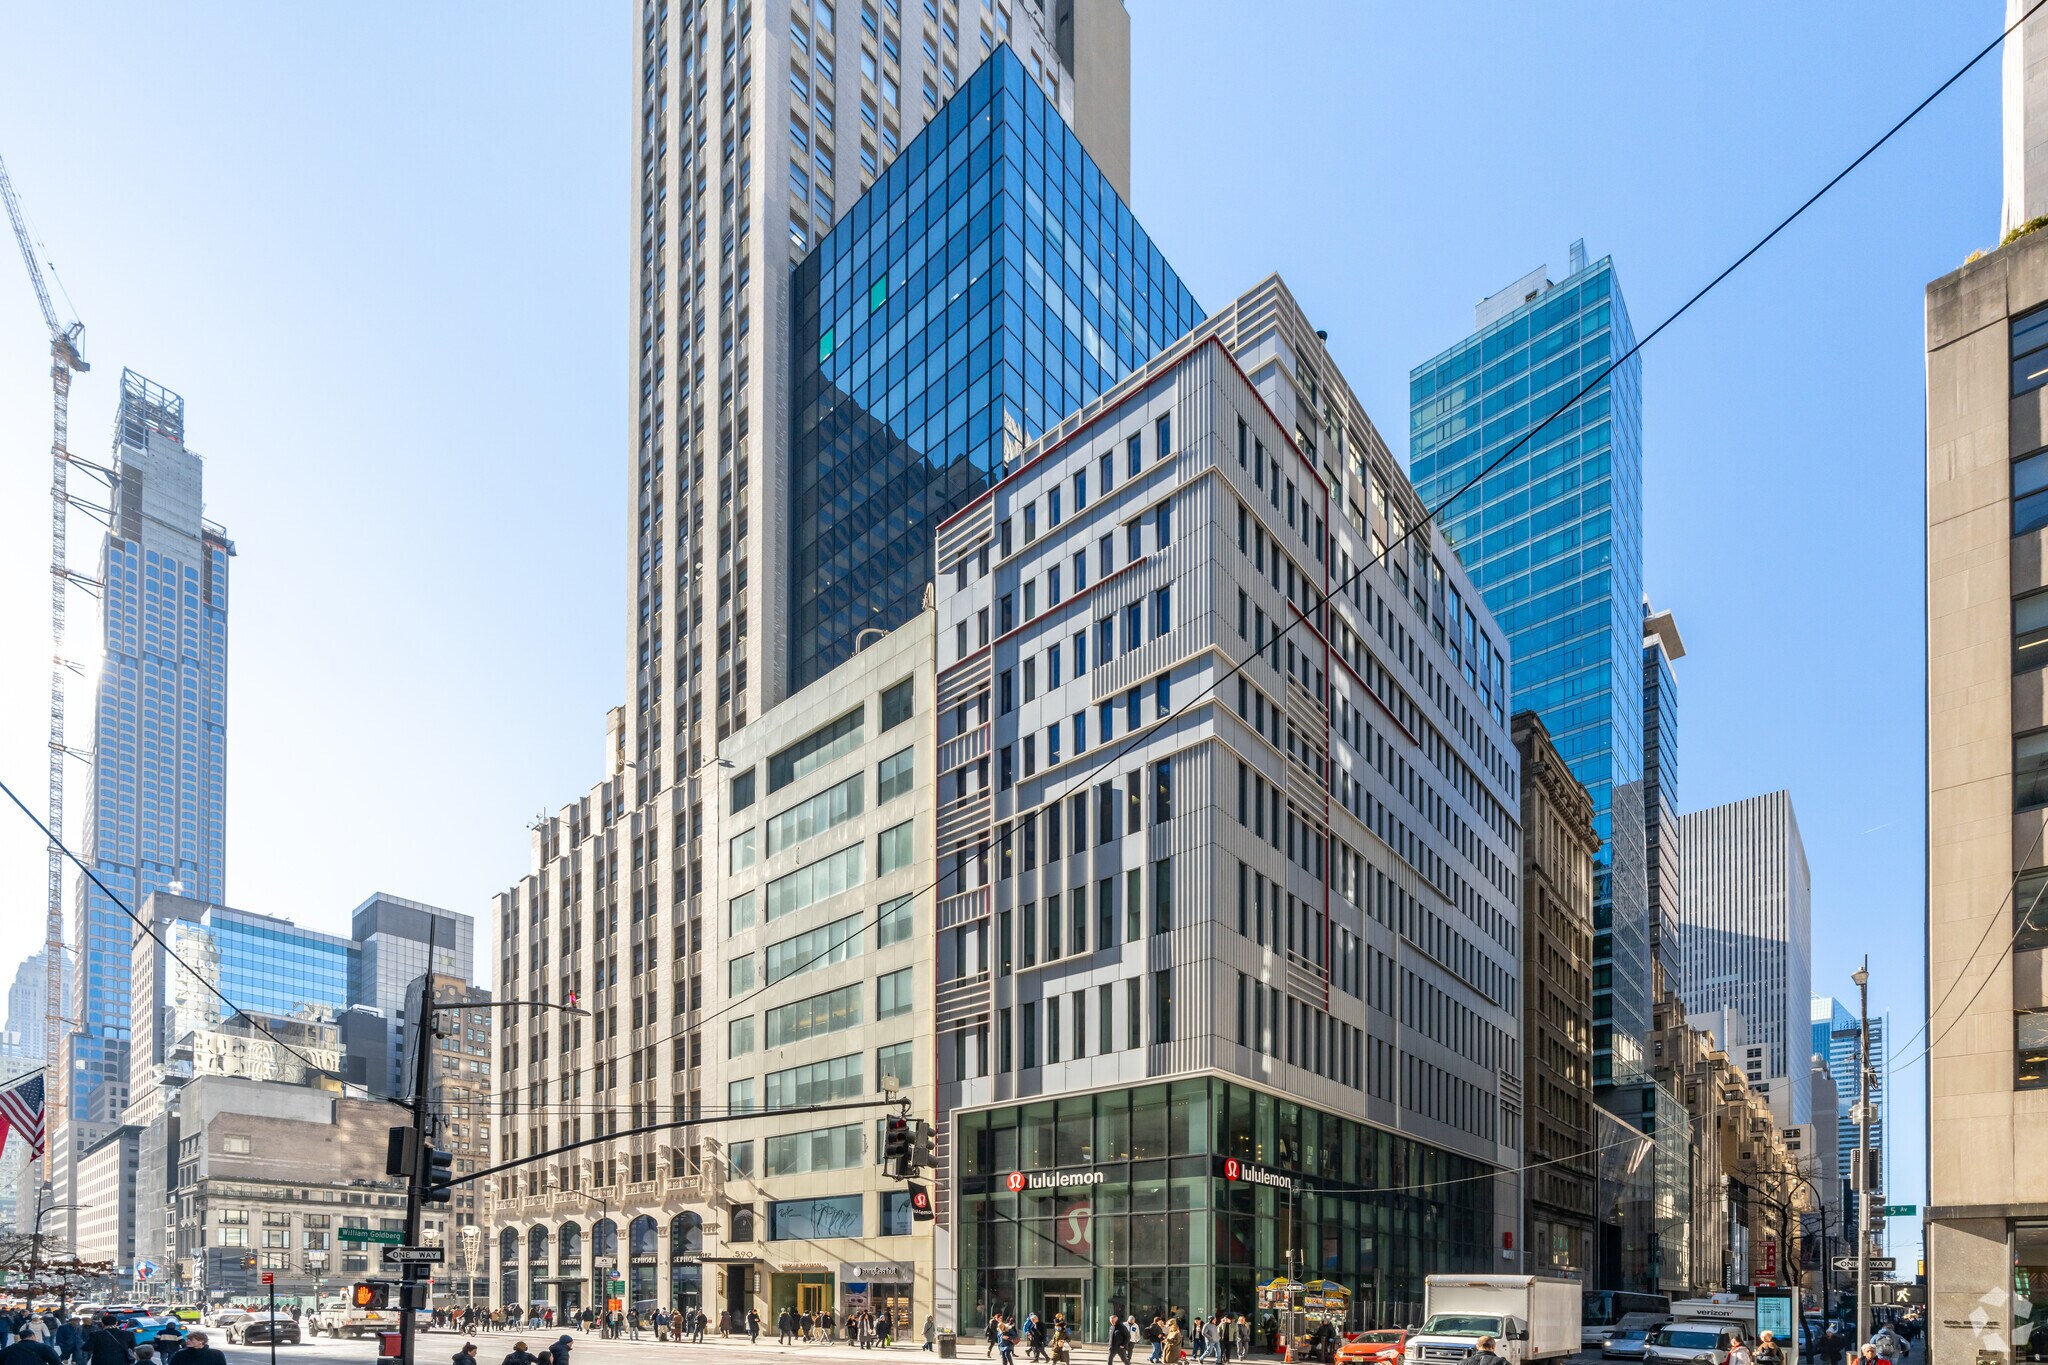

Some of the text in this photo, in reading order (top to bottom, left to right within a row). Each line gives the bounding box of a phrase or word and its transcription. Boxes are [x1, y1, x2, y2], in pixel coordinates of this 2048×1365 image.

[1029, 1171, 1104, 1189] lululemon
[1241, 1163, 1291, 1188] lululemon
[1890, 1206, 1896, 1215] 5
[342, 1229, 401, 1241] William Goldberg
